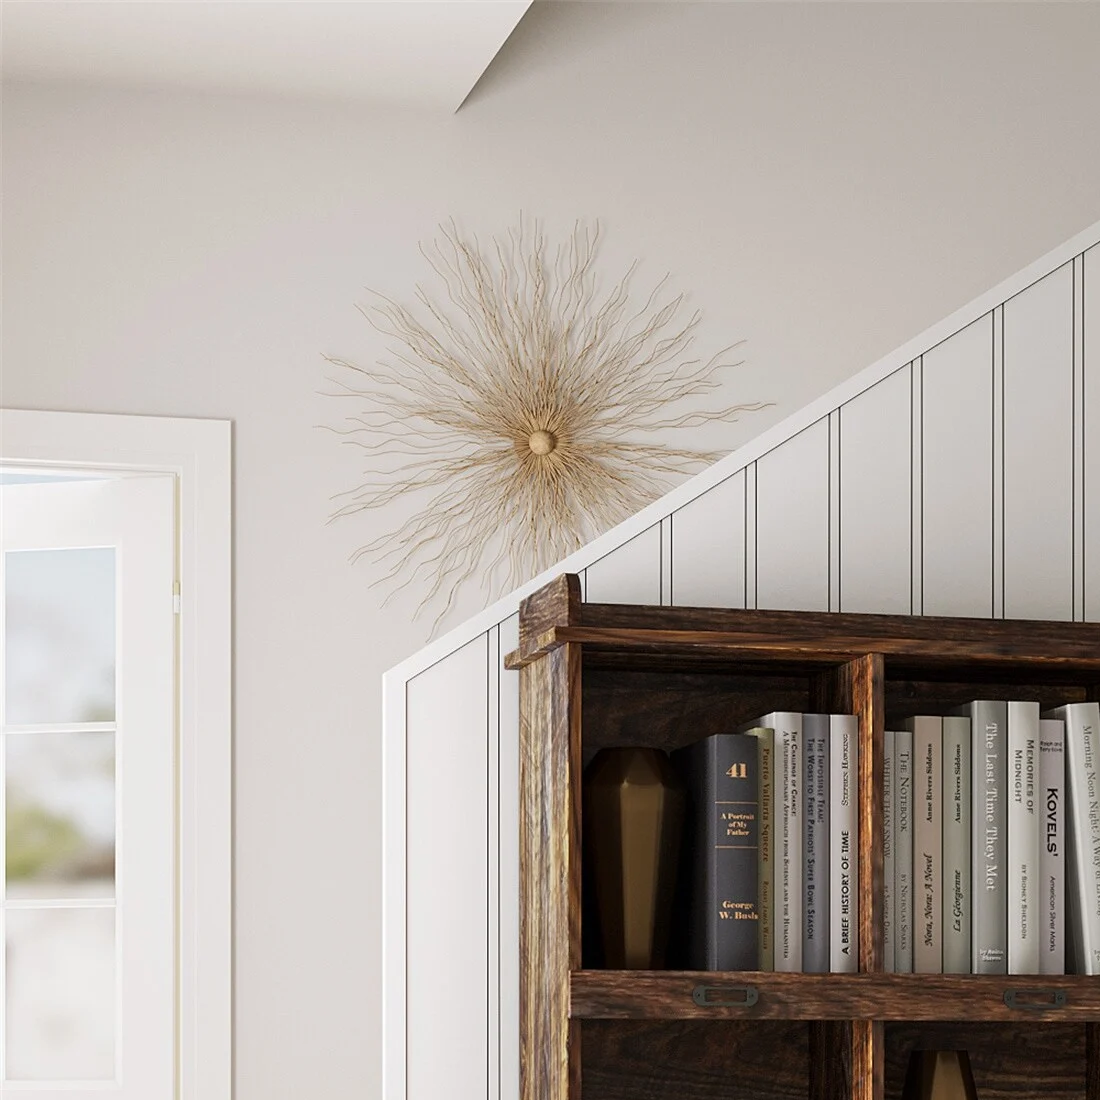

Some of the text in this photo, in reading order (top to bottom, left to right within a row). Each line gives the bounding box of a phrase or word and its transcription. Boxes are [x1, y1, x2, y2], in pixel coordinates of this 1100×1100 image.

[1083, 725, 1095, 768] Morning
[726, 763, 747, 778] 41
[1087, 772, 1097, 798] Noon
[983, 723, 997, 890] The Last Time They Met
[1088, 801, 1099, 833] Night:
[1092, 836, 1100, 844] A
[722, 900, 754, 910] George
[841, 831, 849, 955] A BRIEF HISTORY OF TIME
[719, 912, 758, 920] W. Bush
